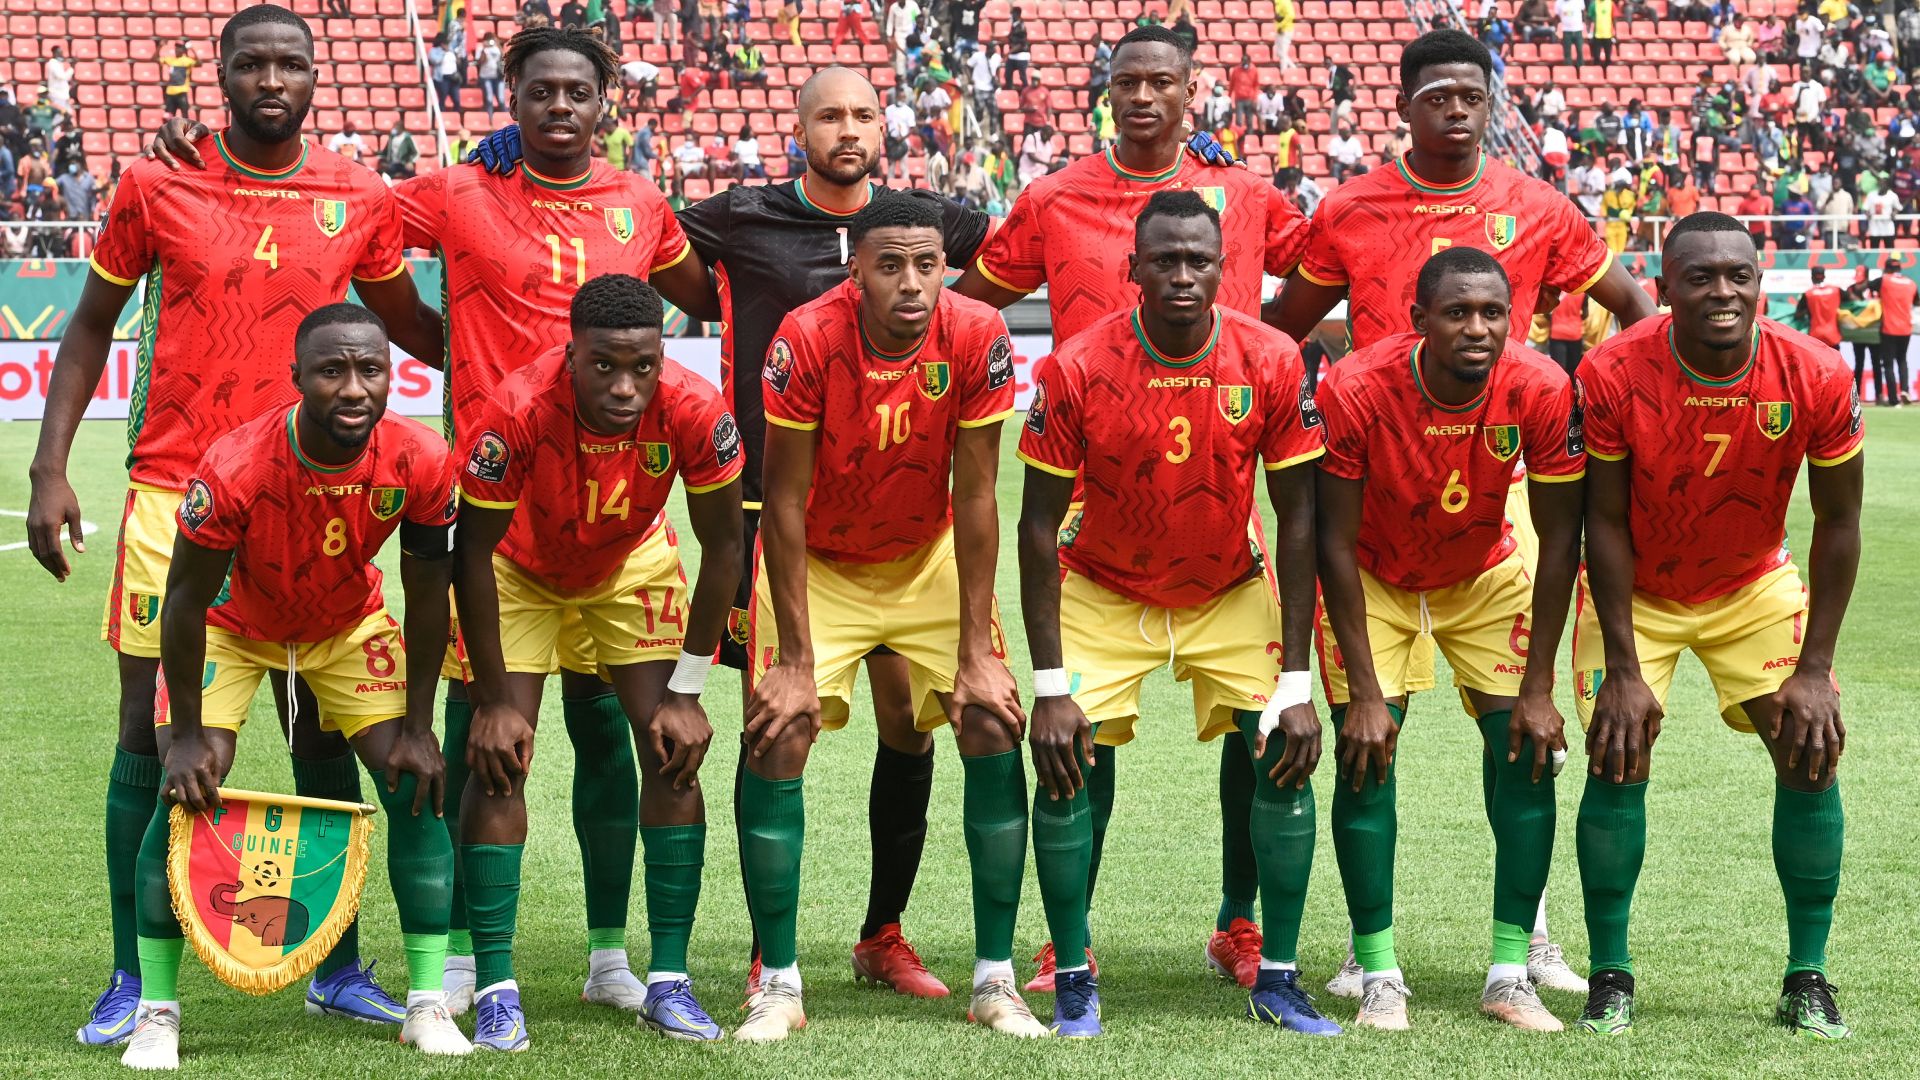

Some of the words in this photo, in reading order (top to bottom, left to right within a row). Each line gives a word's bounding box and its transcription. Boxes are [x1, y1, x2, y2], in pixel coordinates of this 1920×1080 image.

[253, 224, 278, 270] 4
[545, 234, 586, 287] 11
[835, 227, 849, 265] 1
[875, 401, 911, 451] 10
[1165, 415, 1192, 464] 3
[1703, 433, 1732, 477] 7
[586, 478, 630, 524] 14
[1440, 469, 1470, 514] 6
[322, 517, 347, 557] 8
[634, 586, 684, 635] 14
[363, 636, 396, 679] 8
[264, 804, 284, 833] G
[317, 810, 334, 838] F
